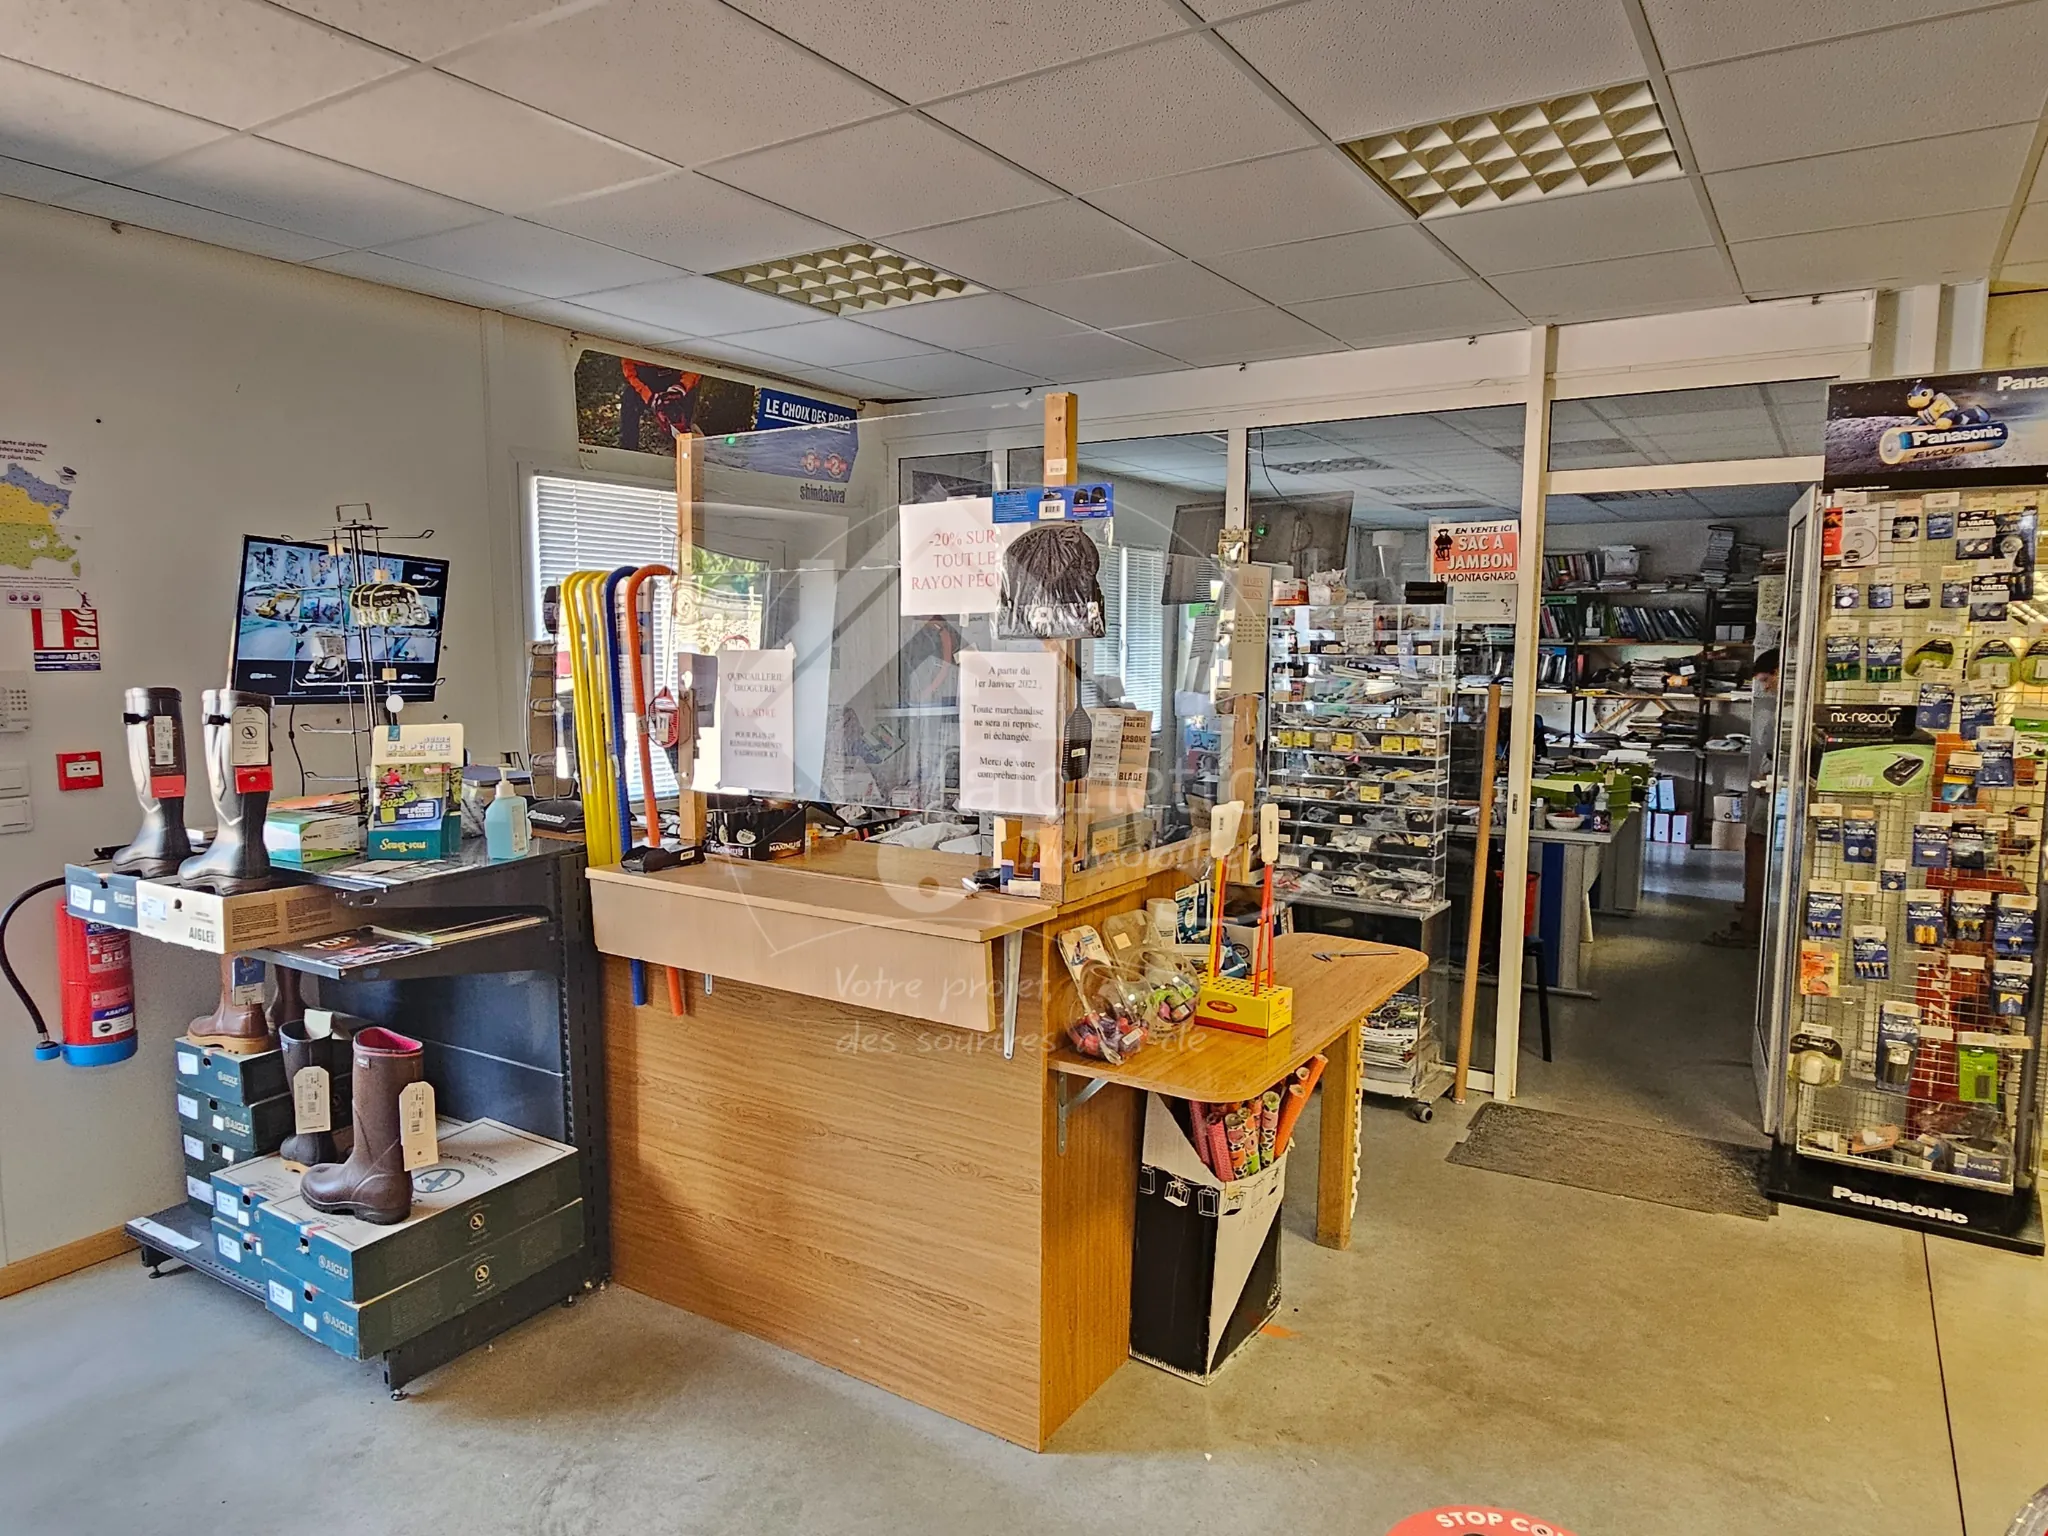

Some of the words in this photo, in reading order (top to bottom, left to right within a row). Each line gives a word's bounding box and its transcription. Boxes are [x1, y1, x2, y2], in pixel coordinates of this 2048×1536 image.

[765, 398, 780, 414] LE
[781, 402, 810, 421] CHOIX
[811, 409, 827, 423] DES
[828, 413, 851, 429] PROS
[1912, 426, 2002, 446] Panasonic
[1913, 446, 1965, 459] EVOLTA
[800, 482, 846, 504] shindaiwa
[1470, 526, 1498, 534] VENTE
[928, 532, 962, 547] -20%
[966, 529, 996, 544] SUR
[1458, 535, 1490, 552] SAC
[1493, 534, 1504, 550] A
[934, 552, 974, 568] TOUT
[978, 552, 996, 566] LE
[1447, 552, 1514, 570] JAMBON
[911, 574, 963, 590] RAYON
[1448, 572, 1516, 582] MONTAGNARD
[1828, 645, 1860, 653] VARTA
[996, 667, 1018, 677] partir
[1020, 666, 1031, 676] du
[734, 684, 776, 693] DROGUERIE
[988, 679, 1016, 688] Janvier
[1920, 692, 1954, 700] VARTA
[972, 704, 993, 714] Toute
[995, 705, 1044, 715] marchandise
[1831, 707, 1897, 726] nx-ready
[1012, 720, 1042, 730] reprise,
[993, 732, 1032, 743] échangée.
[979, 756, 1002, 766] Merci
[1004, 757, 1013, 766] de
[977, 771, 1038, 781] compréhension.
[1119, 772, 1142, 781] BLADE
[380, 798, 406, 808] 2025
[769, 839, 802, 852] MAXIMUS
[1810, 902, 1842, 910] VARTA
[1998, 916, 2033, 924] VARTA
[305, 934, 351, 948] TOP
[1994, 980, 2029, 989] VARTA
[1882, 1024, 1918, 1034] VARTA
[1968, 1162, 2000, 1173] VARTA
[1832, 1185, 1968, 1224] Panasonic
[326, 1260, 349, 1279] AIGLE
[330, 1316, 354, 1336] AIGLE
[1436, 1510, 1504, 1528] STOP
[1510, 1517, 1564, 1536] CO
